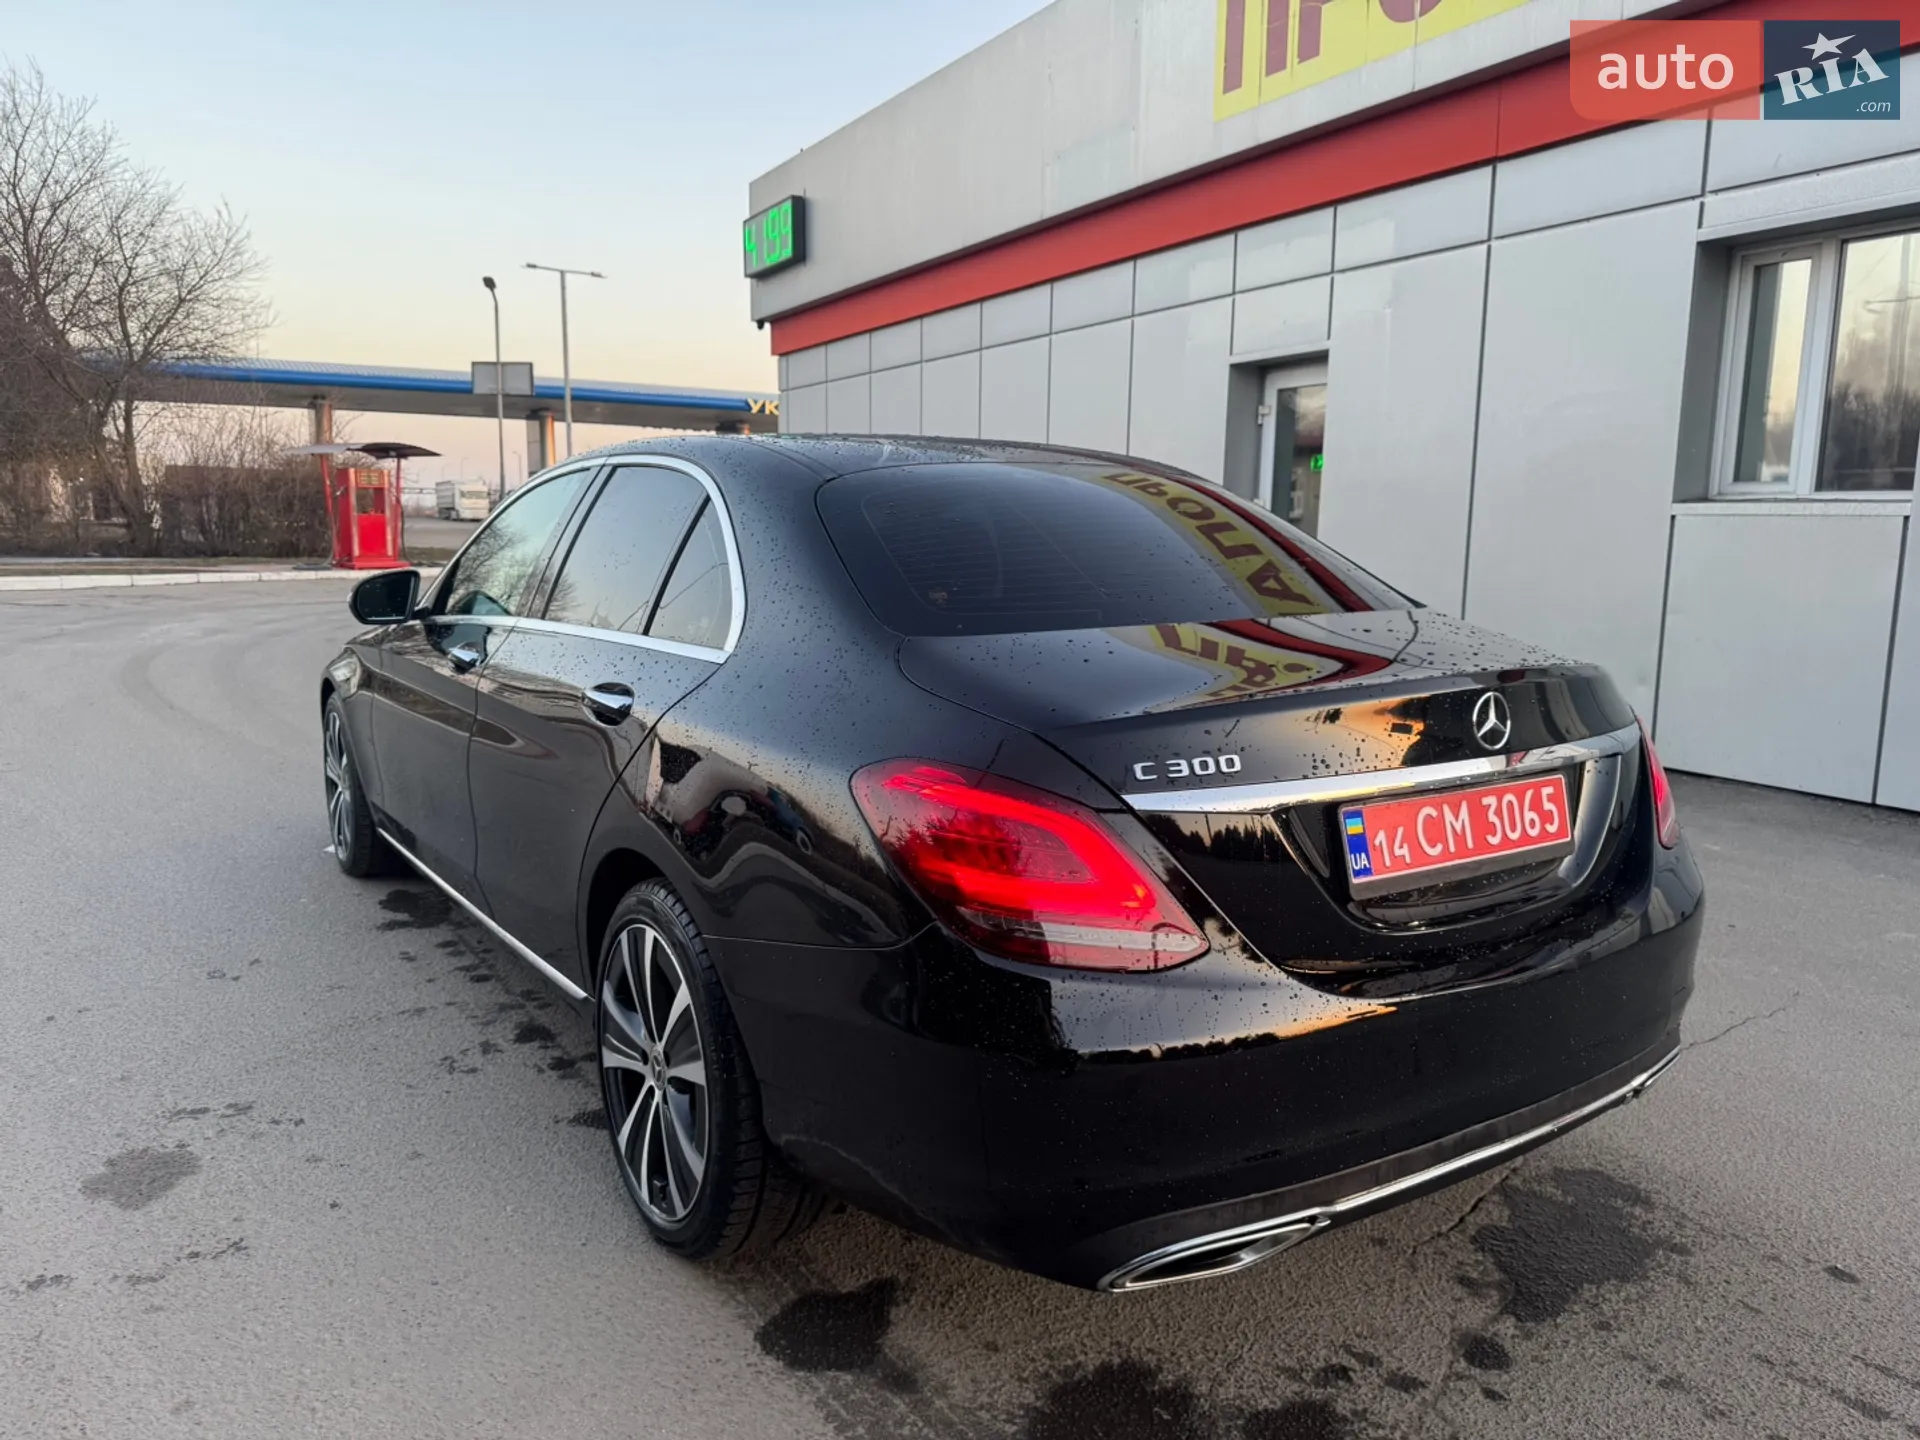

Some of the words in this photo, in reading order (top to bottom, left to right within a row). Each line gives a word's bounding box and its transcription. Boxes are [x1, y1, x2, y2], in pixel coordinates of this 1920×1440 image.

[1133, 762, 1158, 780] C
[1165, 754, 1241, 777] 300
[1374, 827, 1411, 867] 14
[1481, 786, 1559, 845] 3065
[1351, 853, 1370, 870] UA
